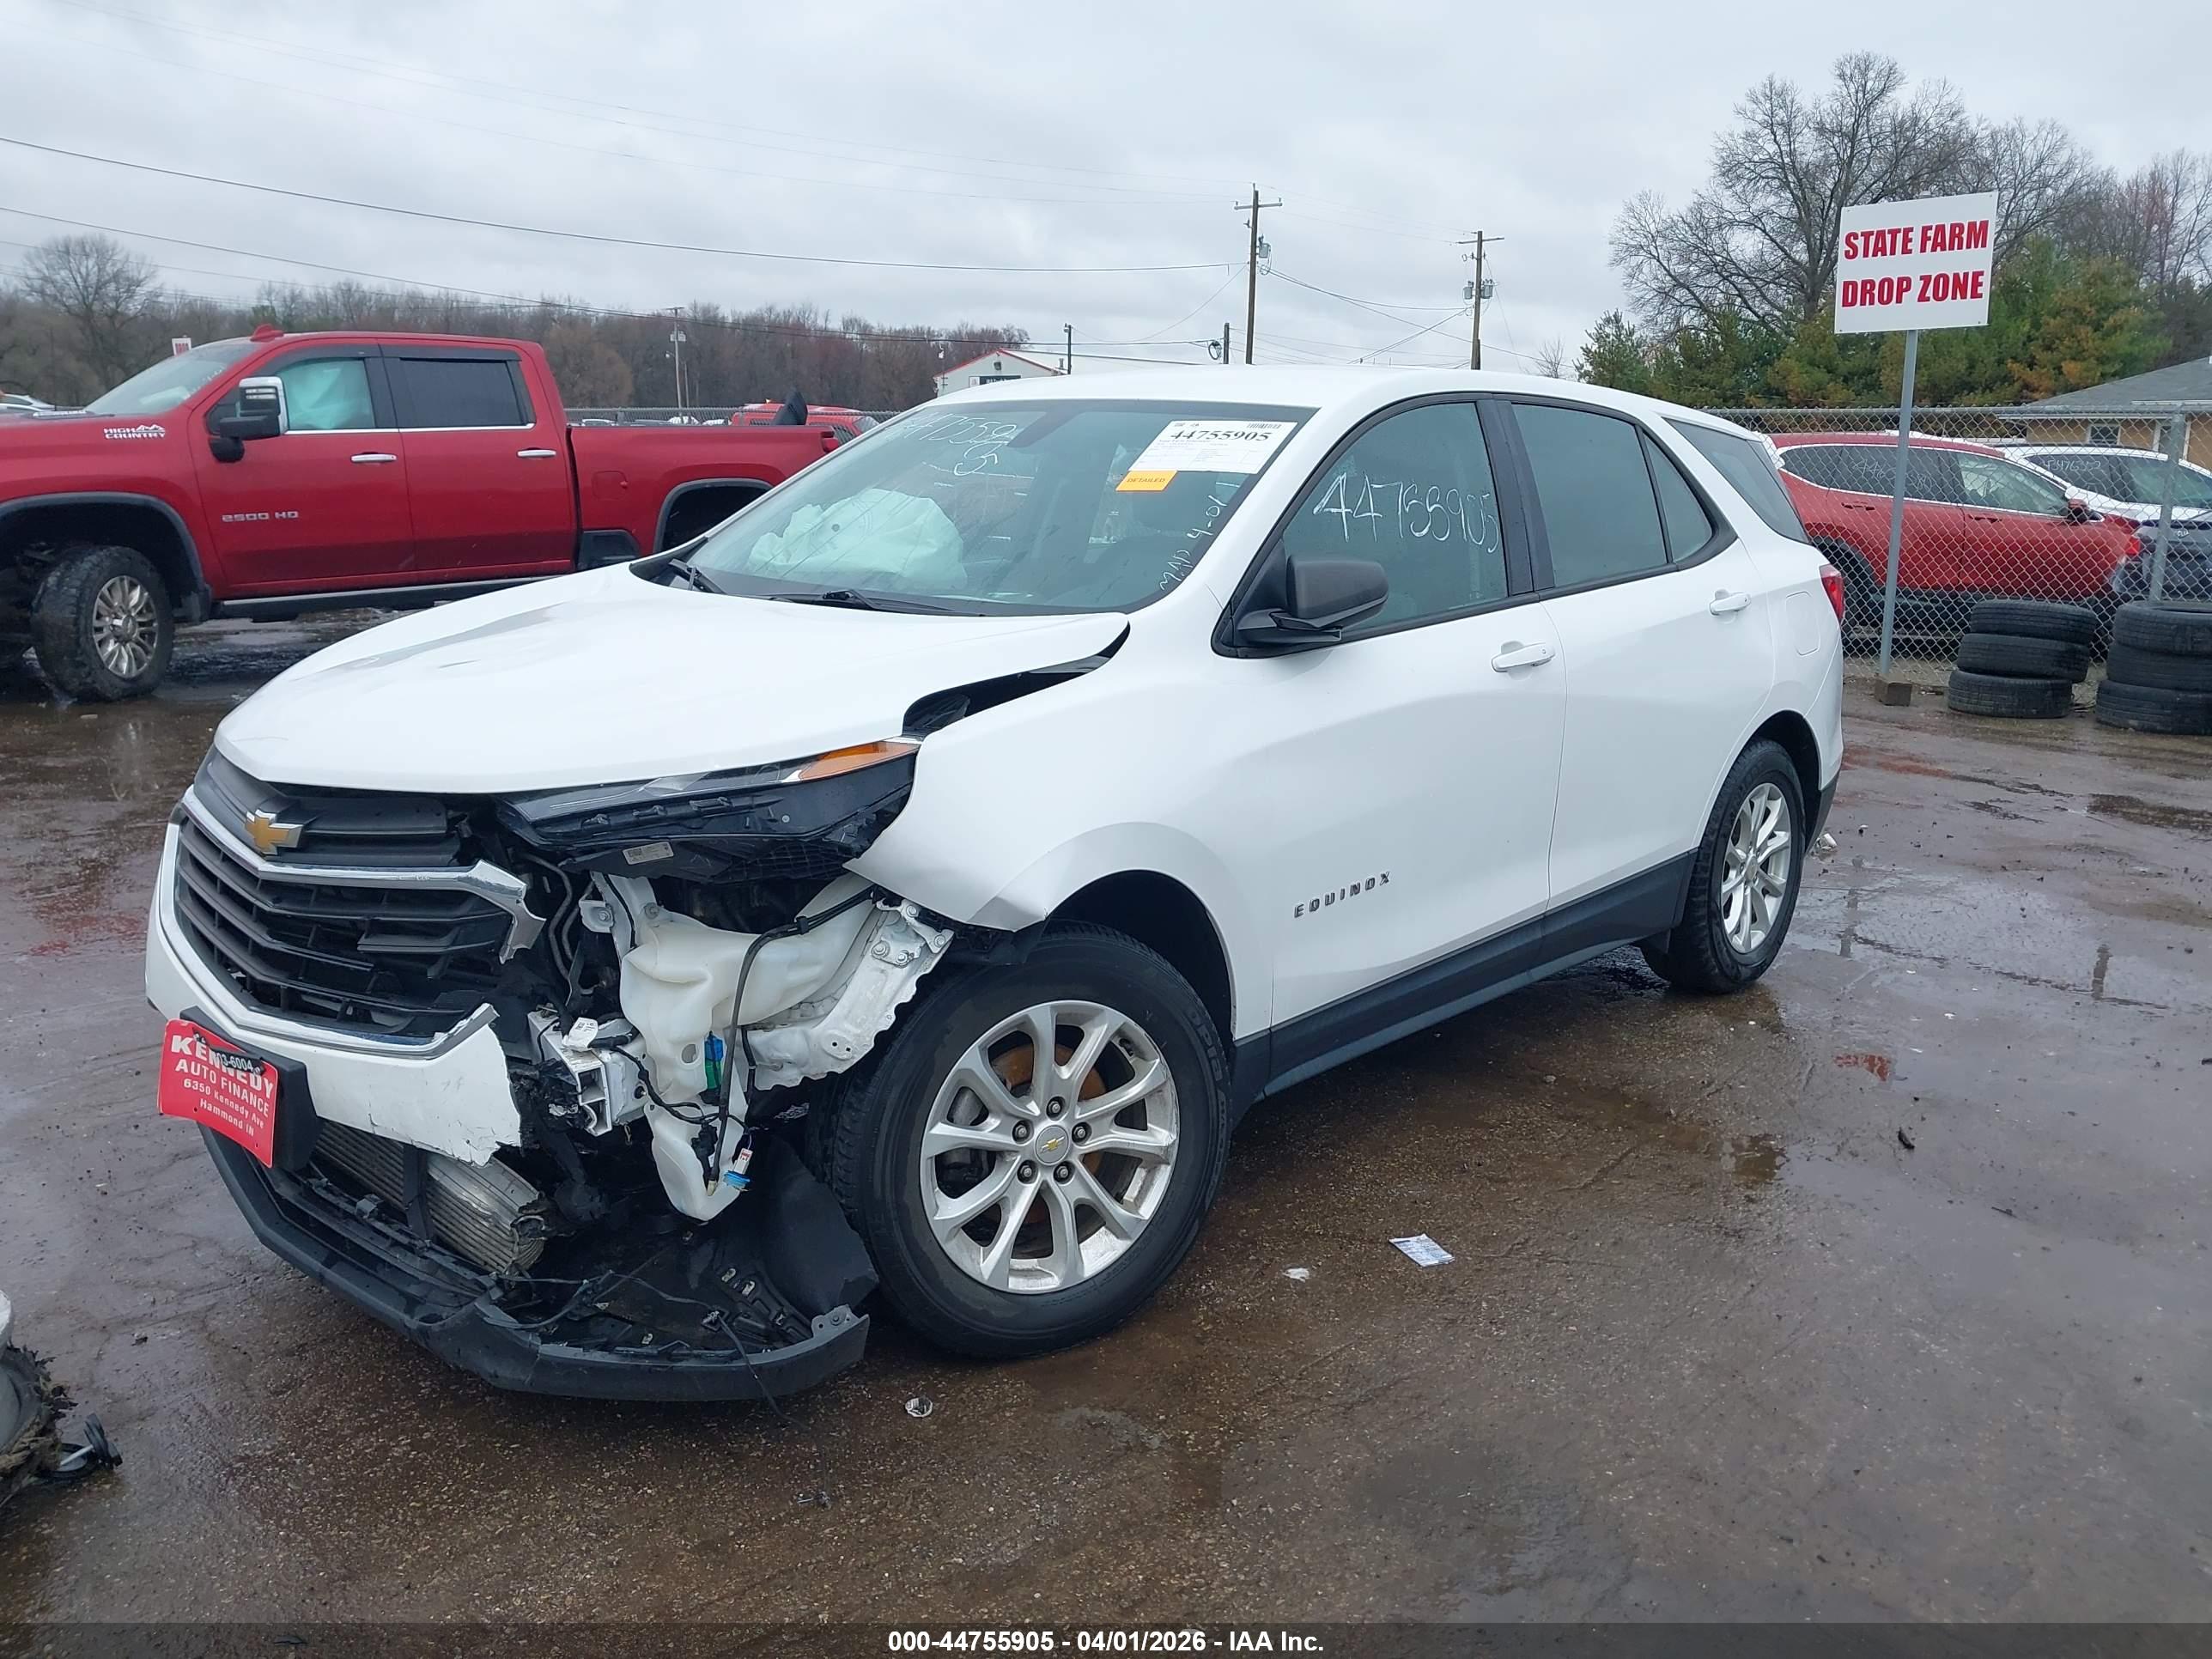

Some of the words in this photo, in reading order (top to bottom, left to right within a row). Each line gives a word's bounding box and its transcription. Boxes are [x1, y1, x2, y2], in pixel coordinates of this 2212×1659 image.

[1844, 227, 1914, 260] STATE
[1919, 220, 1989, 253] FARM
[1841, 276, 1912, 307] DROP
[1917, 270, 1985, 303] ZONE
[1170, 430, 1272, 441] 44755905
[222, 512, 269, 522] 2500
[275, 511, 299, 520] HD
[1312, 471, 1499, 554] 44755905
[1294, 871, 1390, 918] EQUINOX
[171, 1035, 274, 1098] KENNEDY
[175, 1059, 216, 1085] AUTO
[221, 1077, 269, 1118] FINANCE
[184, 1078, 211, 1096] 6350
[215, 1090, 249, 1118] Kennedy
[252, 1112, 264, 1128] Ave
[200, 1098, 243, 1130] Hammond
[246, 1123, 254, 1137] IN
